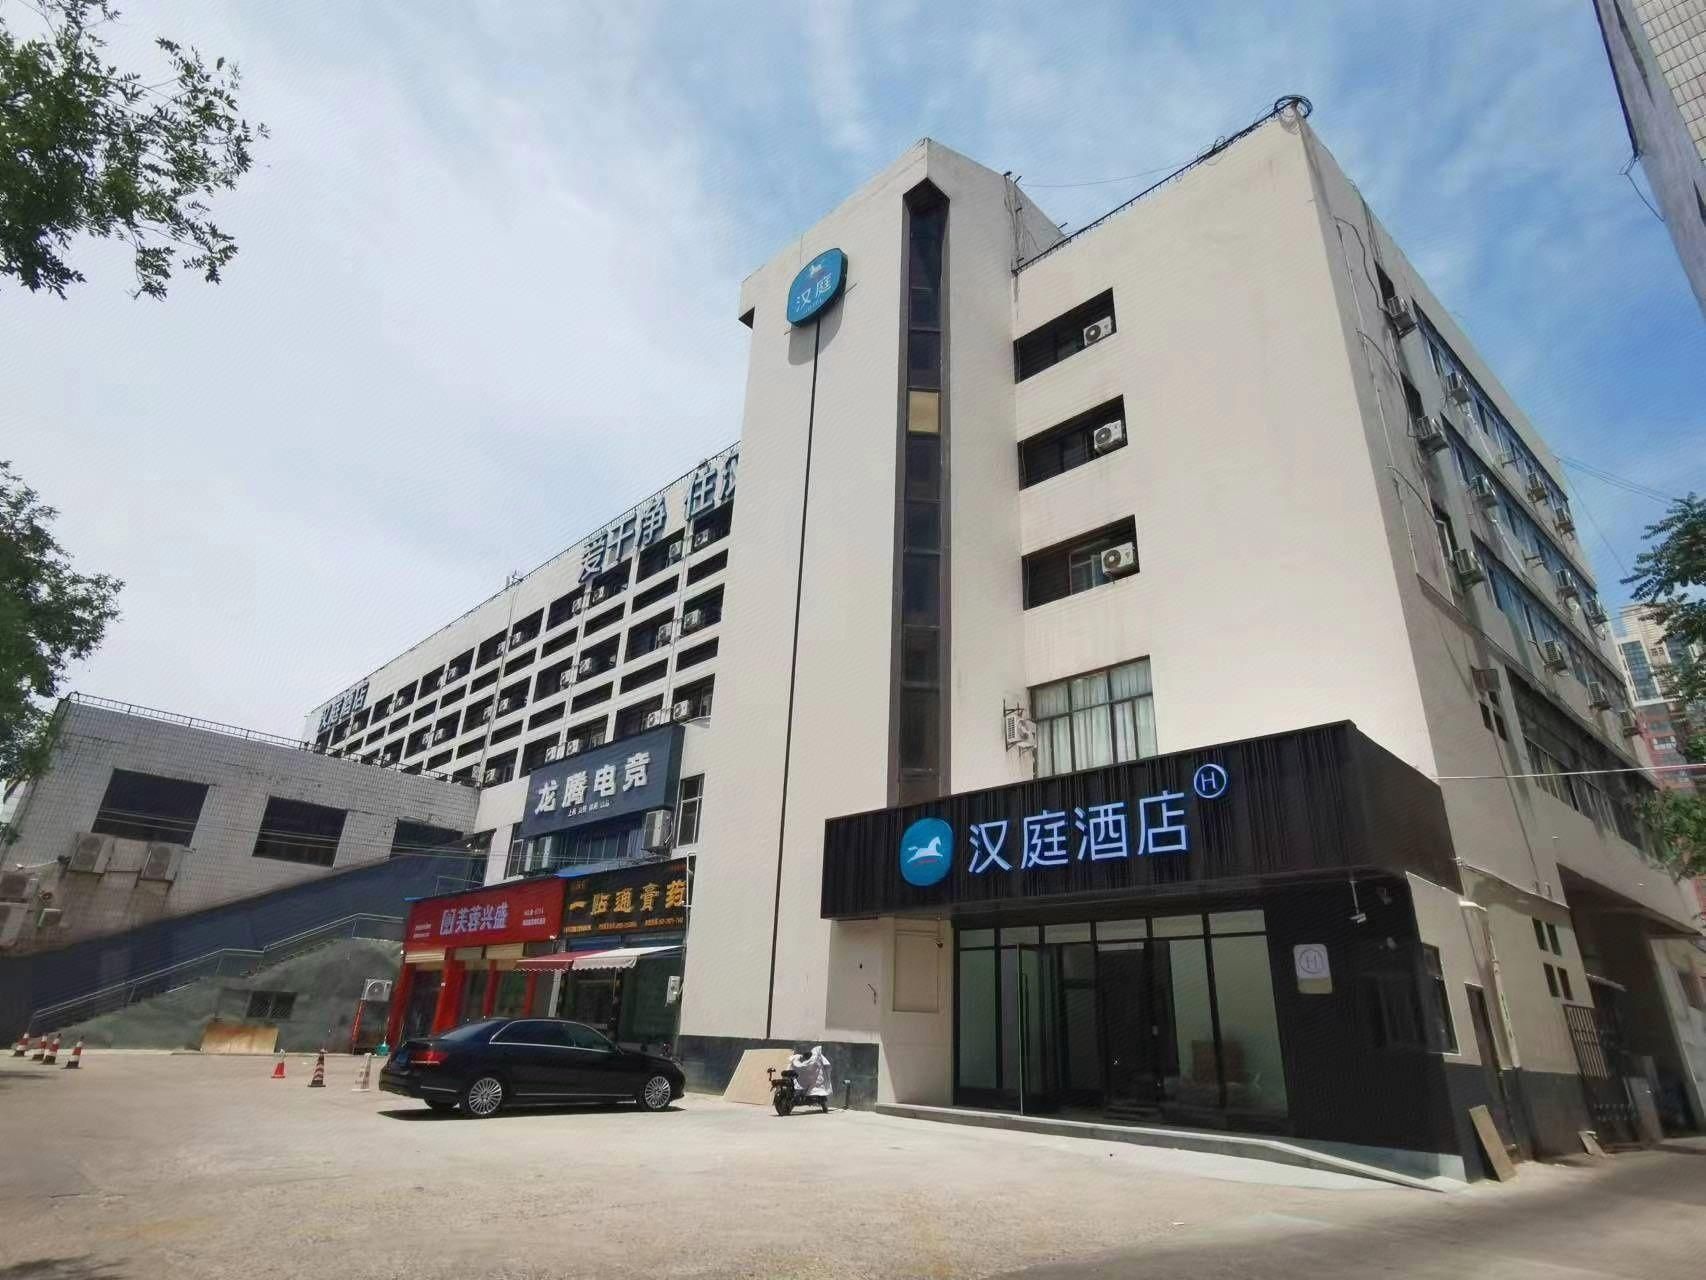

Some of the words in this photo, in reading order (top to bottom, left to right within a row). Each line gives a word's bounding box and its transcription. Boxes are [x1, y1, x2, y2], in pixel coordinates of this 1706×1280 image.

[796, 272, 832, 313] 汉庭
[317, 681, 370, 733] 汉庭酒店
[534, 752, 651, 815] 龙腾电竞
[968, 790, 1188, 874] 汉庭酒店
[455, 901, 509, 933] 芙蓉兴盛
